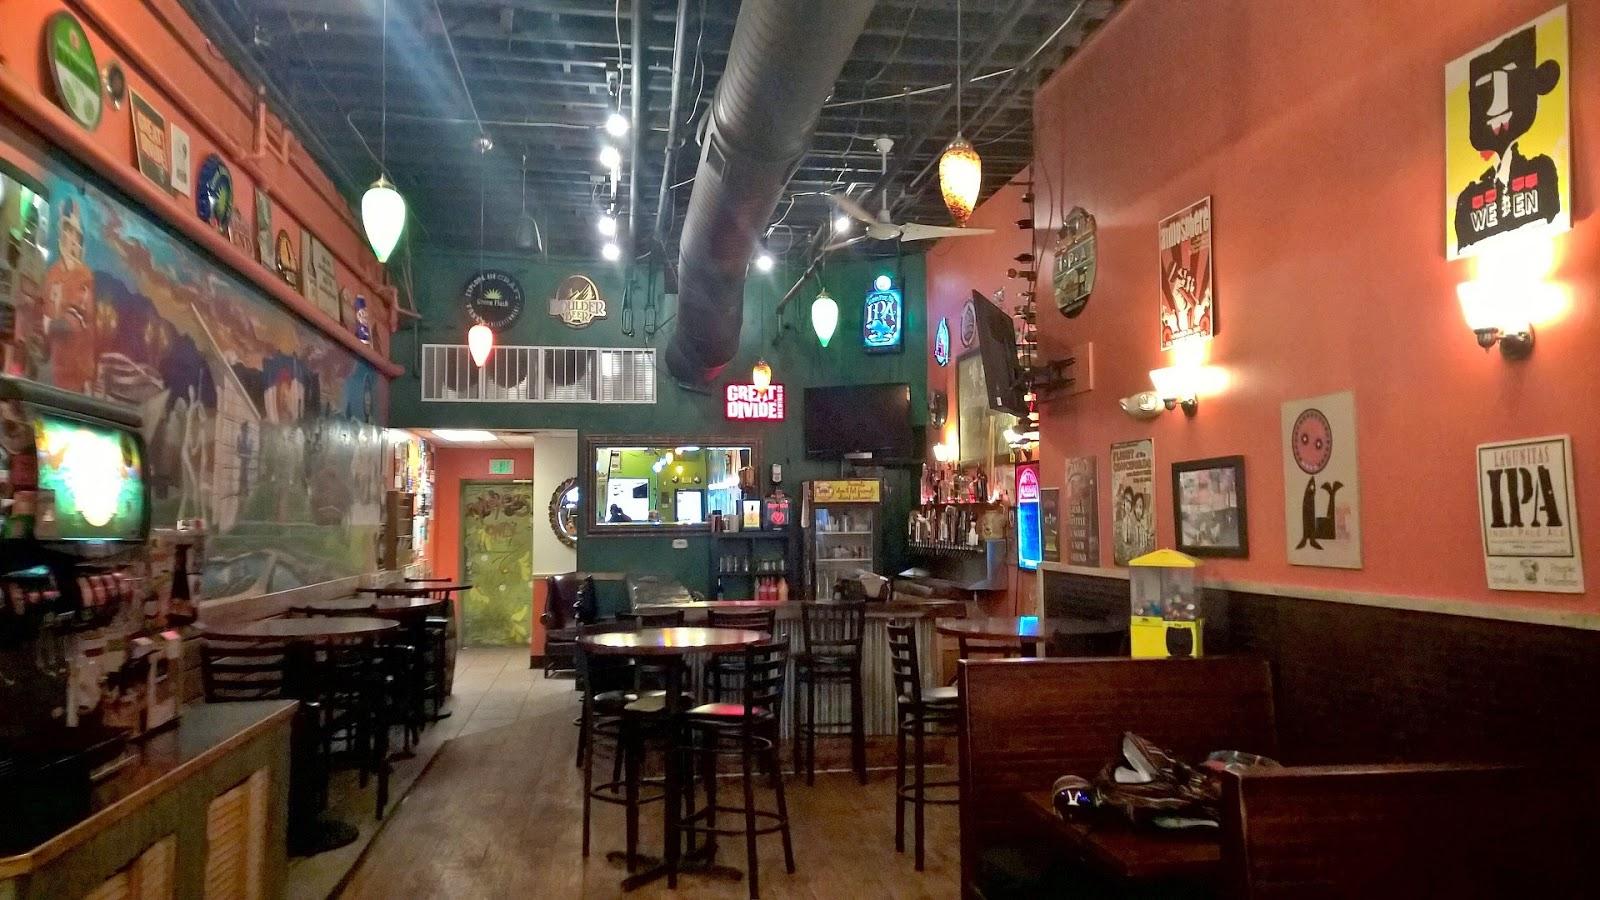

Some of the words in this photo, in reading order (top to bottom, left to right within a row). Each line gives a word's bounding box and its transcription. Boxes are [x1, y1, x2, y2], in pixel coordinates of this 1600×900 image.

[550, 300, 604, 314] OULDER
[565, 311, 589, 321] BEER
[867, 301, 897, 323] IPA
[727, 385, 776, 401] GREAT
[727, 401, 777, 419] DIVIDE
[1494, 446, 1550, 467] LAGUNITAS
[1487, 465, 1563, 528] IPA
